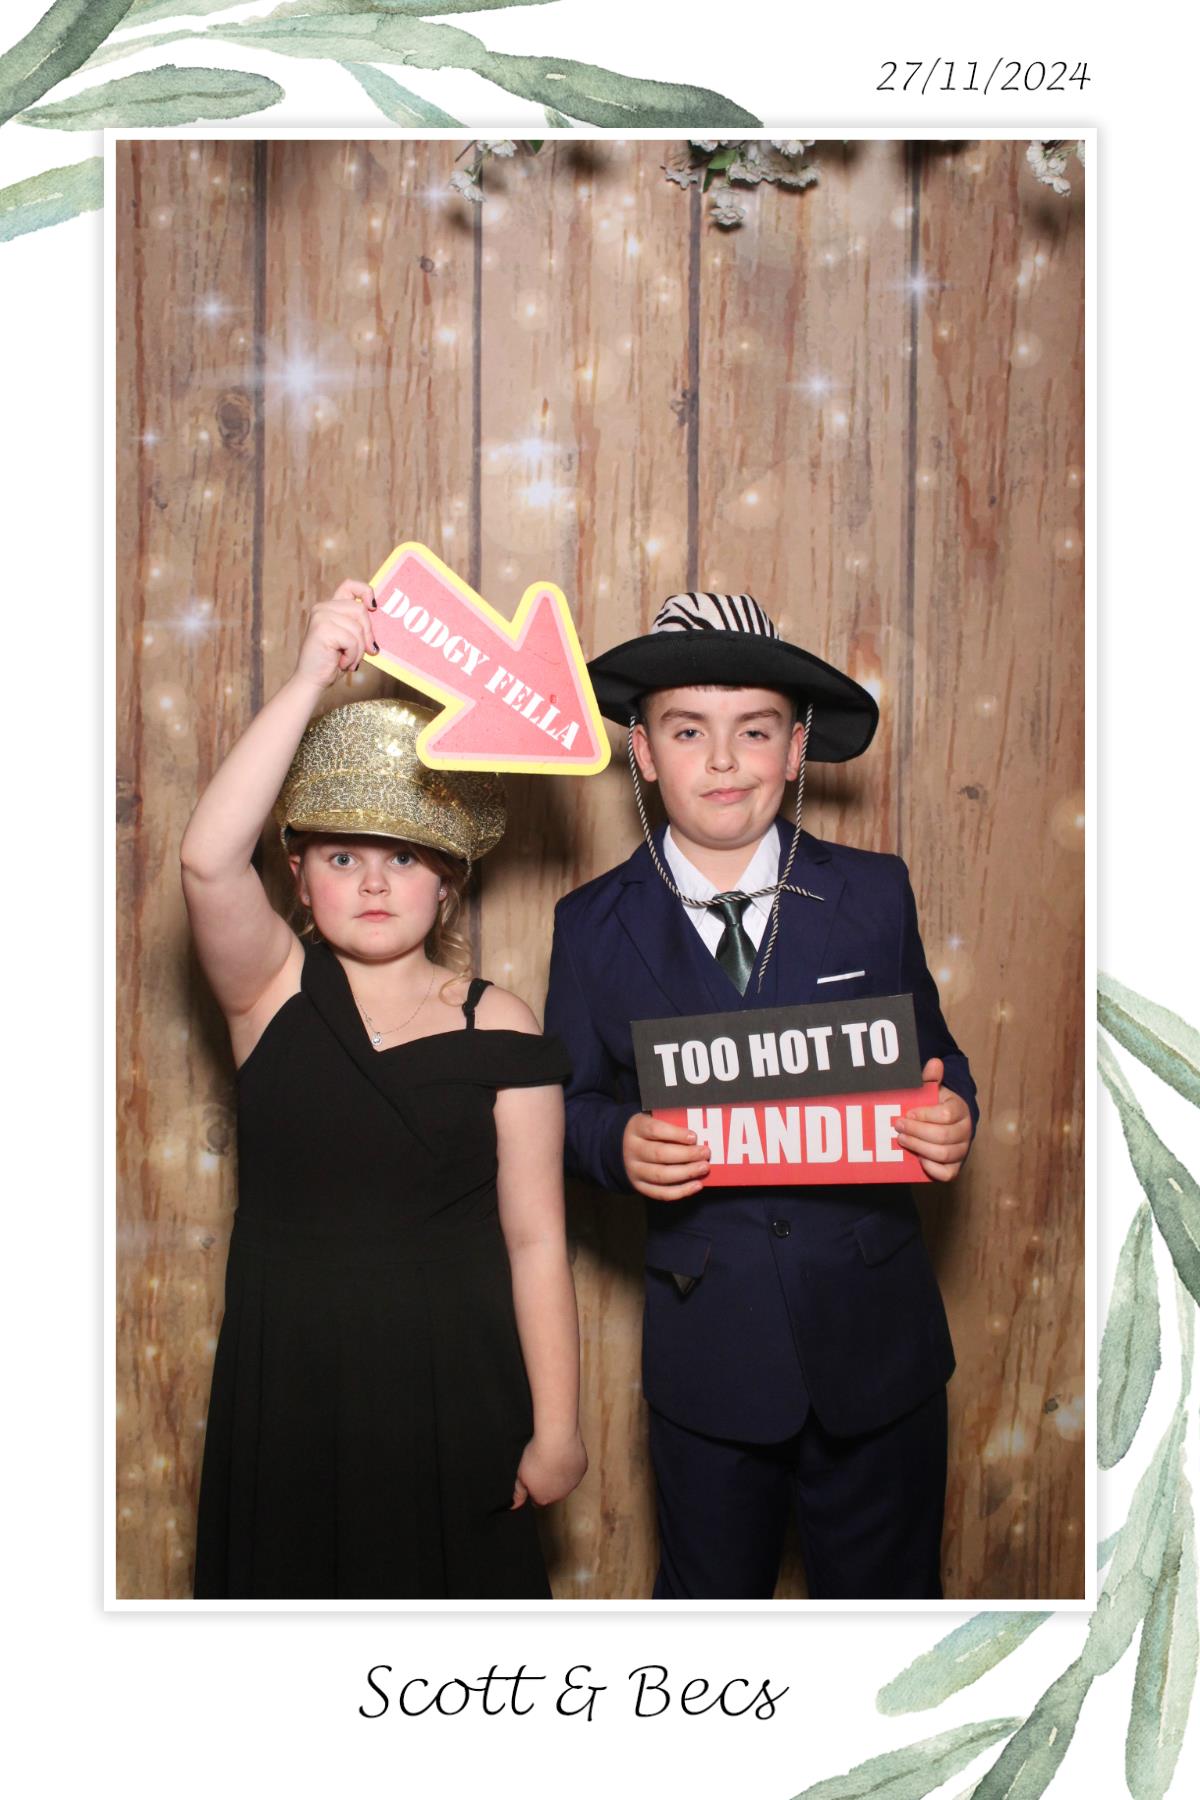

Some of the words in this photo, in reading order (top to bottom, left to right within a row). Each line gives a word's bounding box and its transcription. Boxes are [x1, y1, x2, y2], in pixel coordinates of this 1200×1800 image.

[381, 589, 489, 675] DODGY
[485, 666, 580, 750] FELLA
[653, 1036, 740, 1087] TOO
[748, 1026, 834, 1078] HOT
[841, 1019, 899, 1067] TO
[686, 1104, 904, 1165] HANDLE
